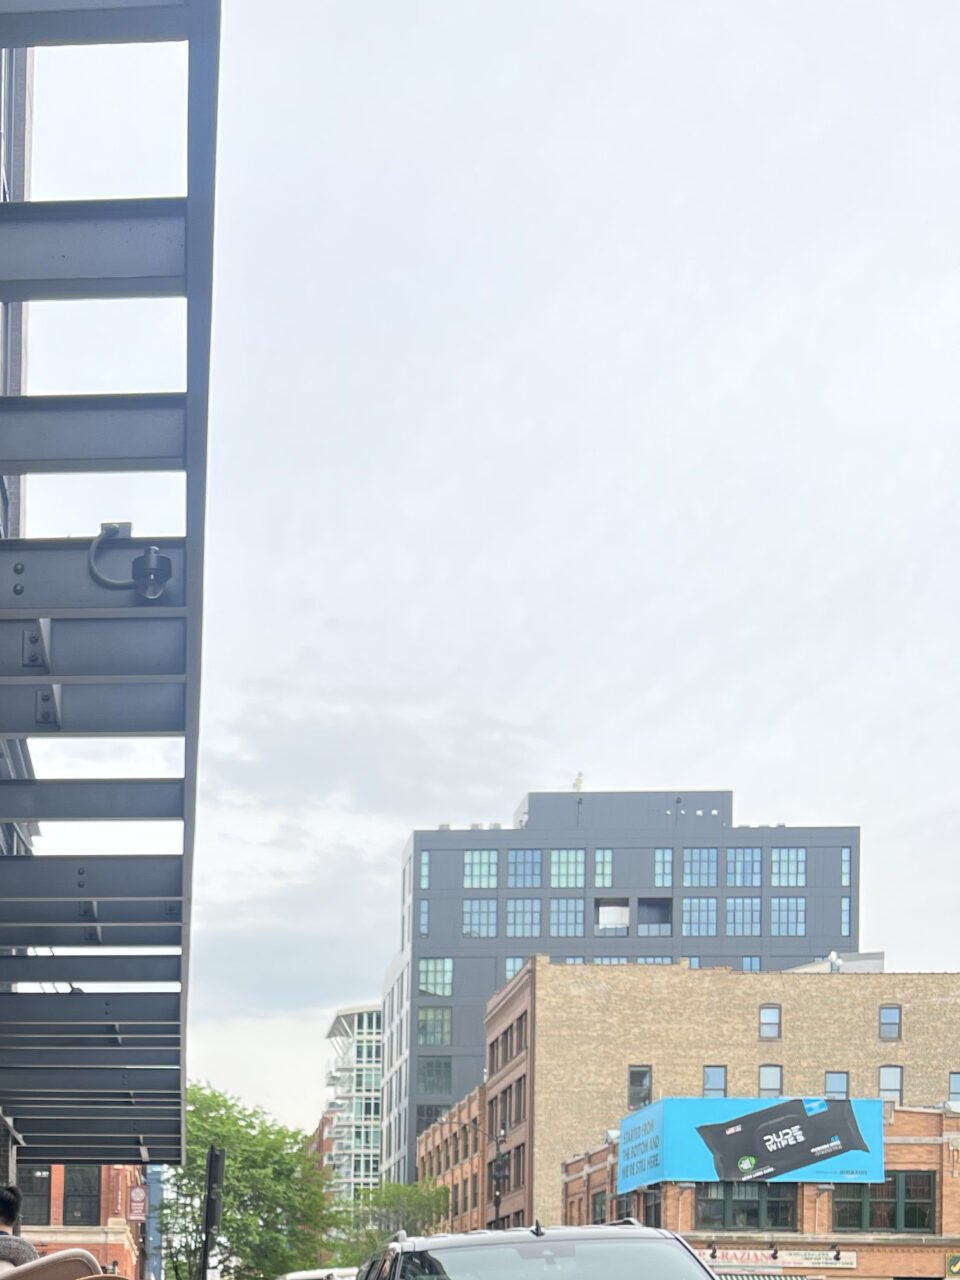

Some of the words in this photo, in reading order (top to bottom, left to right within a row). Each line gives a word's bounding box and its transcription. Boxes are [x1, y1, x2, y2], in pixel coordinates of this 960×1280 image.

[763, 1125, 801, 1144] DUDE
[765, 1133, 806, 1152] WIPES
[717, 1251, 776, 1262] RAZIAN
